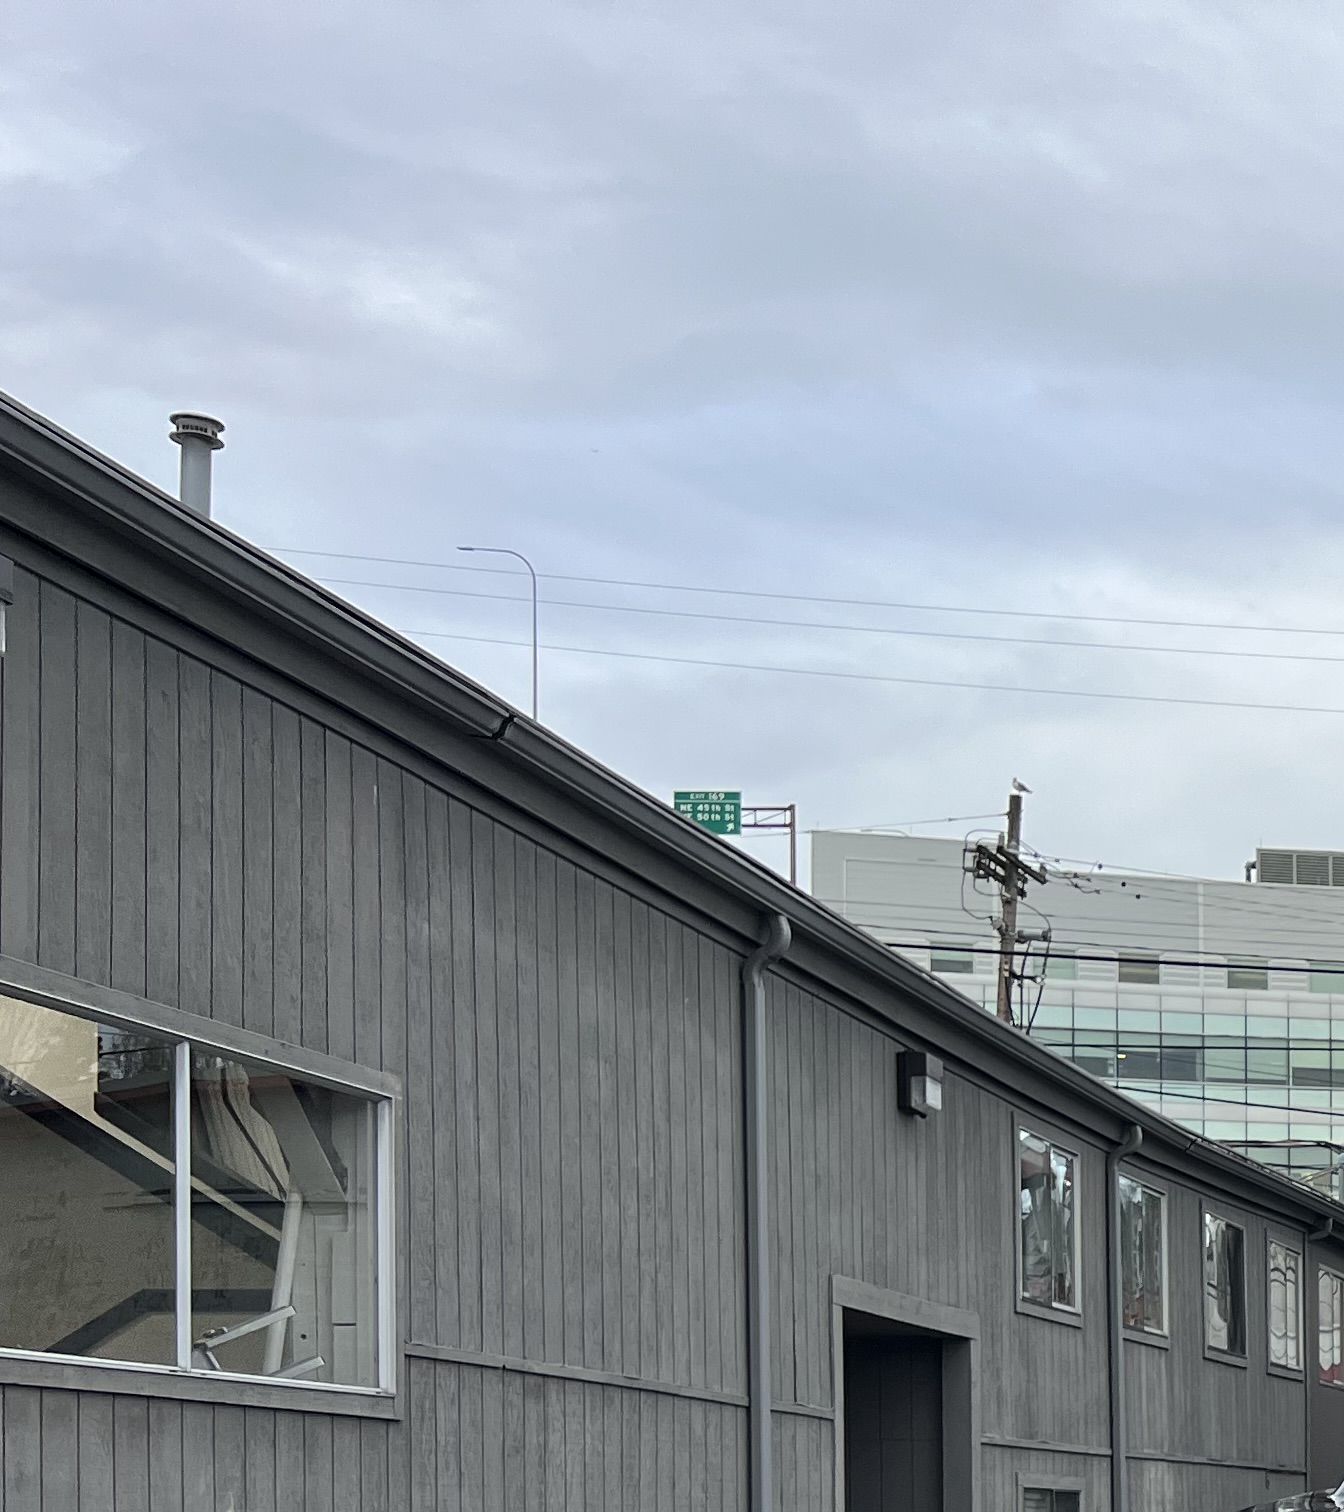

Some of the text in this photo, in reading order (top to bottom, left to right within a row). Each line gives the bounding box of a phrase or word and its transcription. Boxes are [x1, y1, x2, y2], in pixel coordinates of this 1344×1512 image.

[689, 792, 725, 801] EXIT 169
[679, 803, 693, 812] NE
[696, 812, 721, 821] 50th
